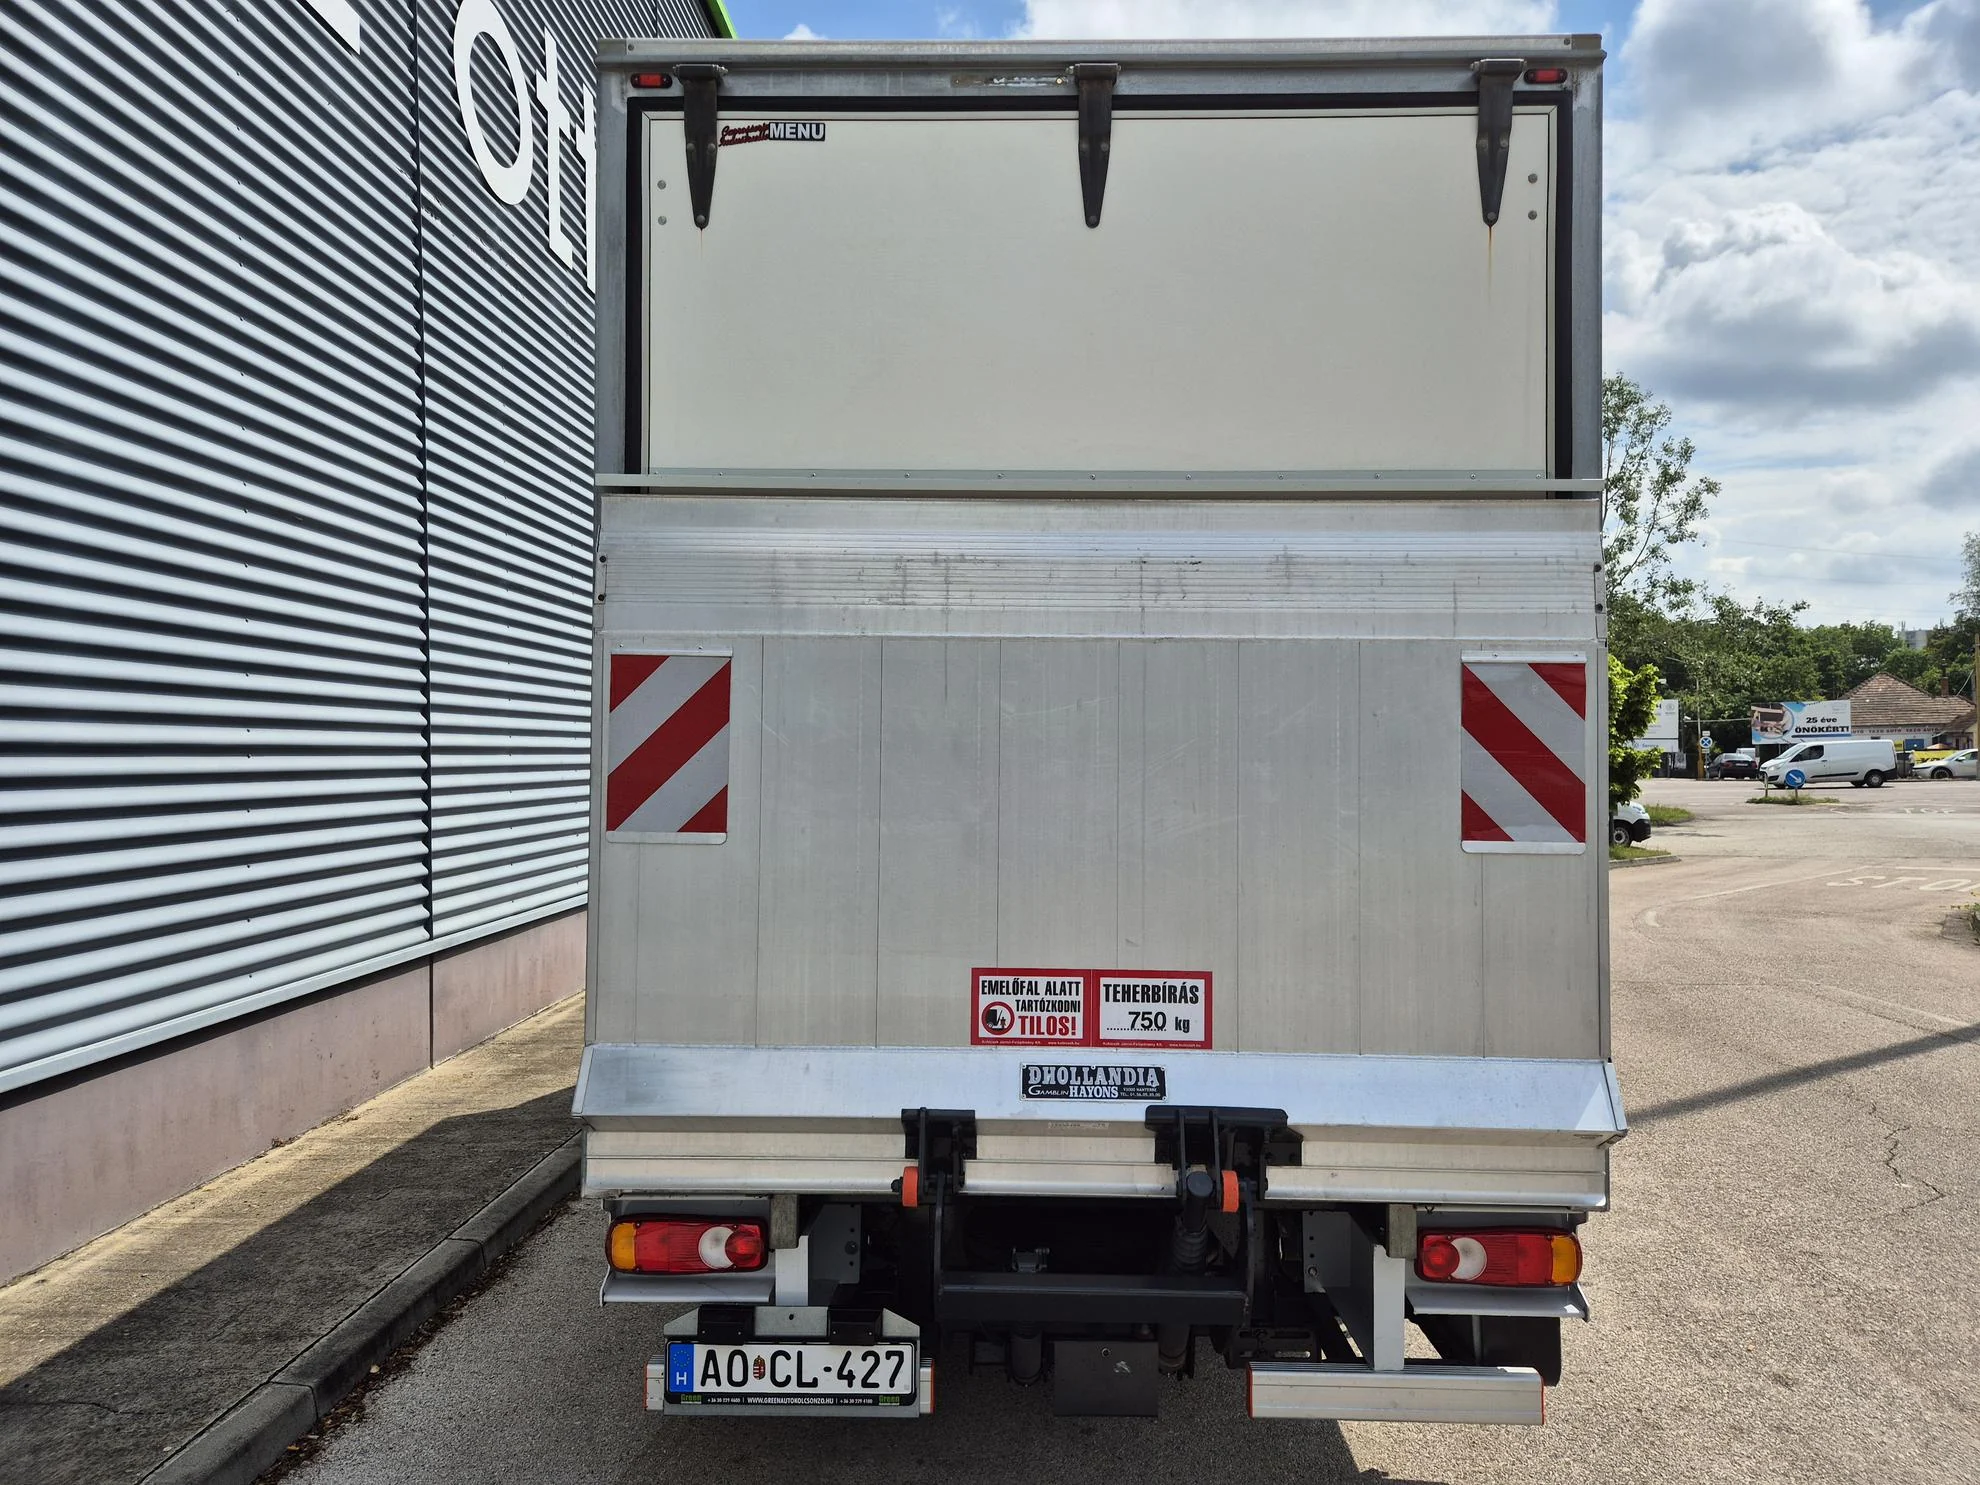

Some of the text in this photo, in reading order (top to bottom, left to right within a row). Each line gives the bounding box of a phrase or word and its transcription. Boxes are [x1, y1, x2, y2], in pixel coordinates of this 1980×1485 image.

[769, 123, 825, 140] MENU
[1826, 874, 1980, 893] STO
[981, 980, 1081, 997] EMELŐFAL ALATT
[1103, 982, 1200, 1005] TEHERBÍRÁS
[1016, 998, 1081, 1013] TARTÓZKODNI
[1018, 1016, 1077, 1036] TILOS!
[1129, 1011, 1190, 1034] 750 kg
[1028, 1066, 1159, 1087] DHOLLANDIA
[1069, 1085, 1119, 1098] HAYONS
[700, 1349, 905, 1389] AO CL-427
[676, 1372, 687, 1385] H
[681, 1394, 701, 1402] Green
